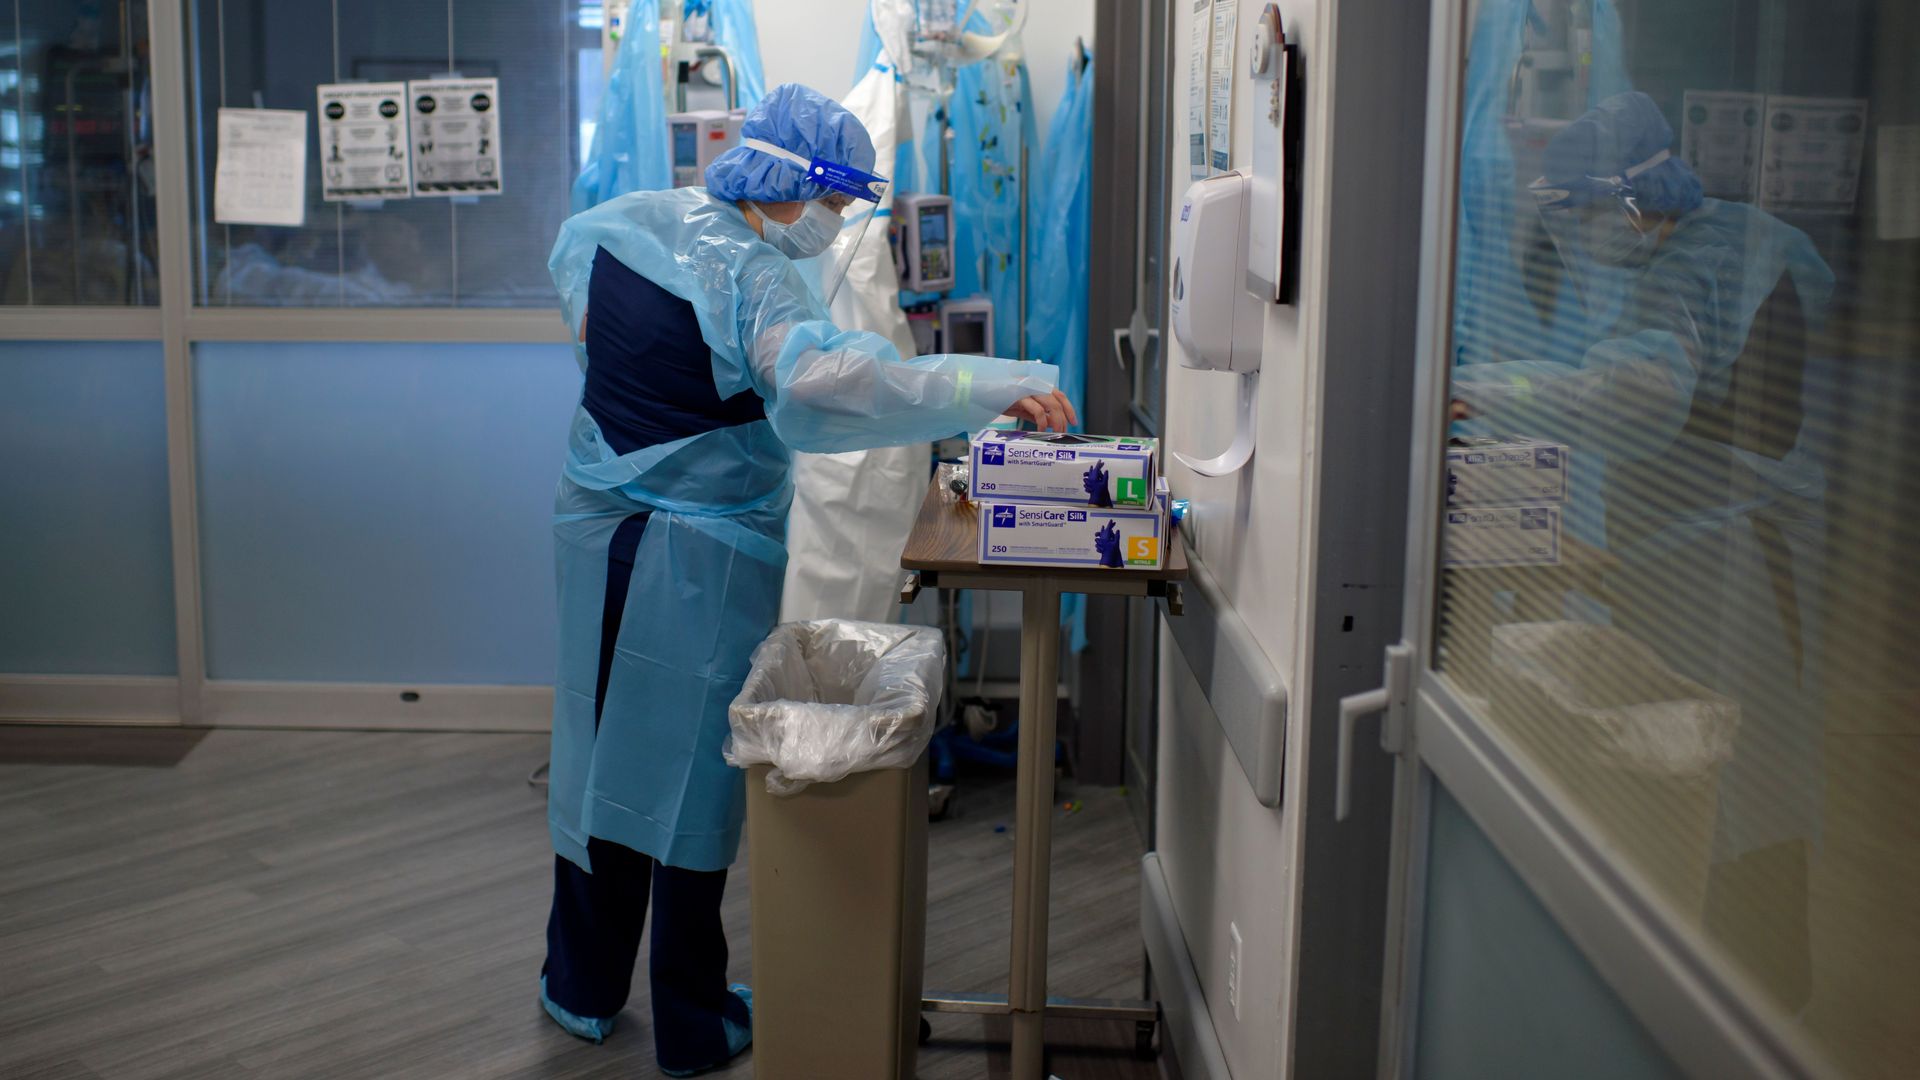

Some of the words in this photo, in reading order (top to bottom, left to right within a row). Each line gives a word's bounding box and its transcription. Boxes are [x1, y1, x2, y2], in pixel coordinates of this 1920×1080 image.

[1008, 447, 1055, 459] SensiCare
[1058, 451, 1073, 460] Silk
[981, 482, 996, 490] 250
[1127, 480, 1138, 498] L
[1019, 509, 1066, 520] SensiCare
[1069, 512, 1084, 520] Silk
[992, 545, 1007, 553] 250
[1137, 540, 1149, 557] S
